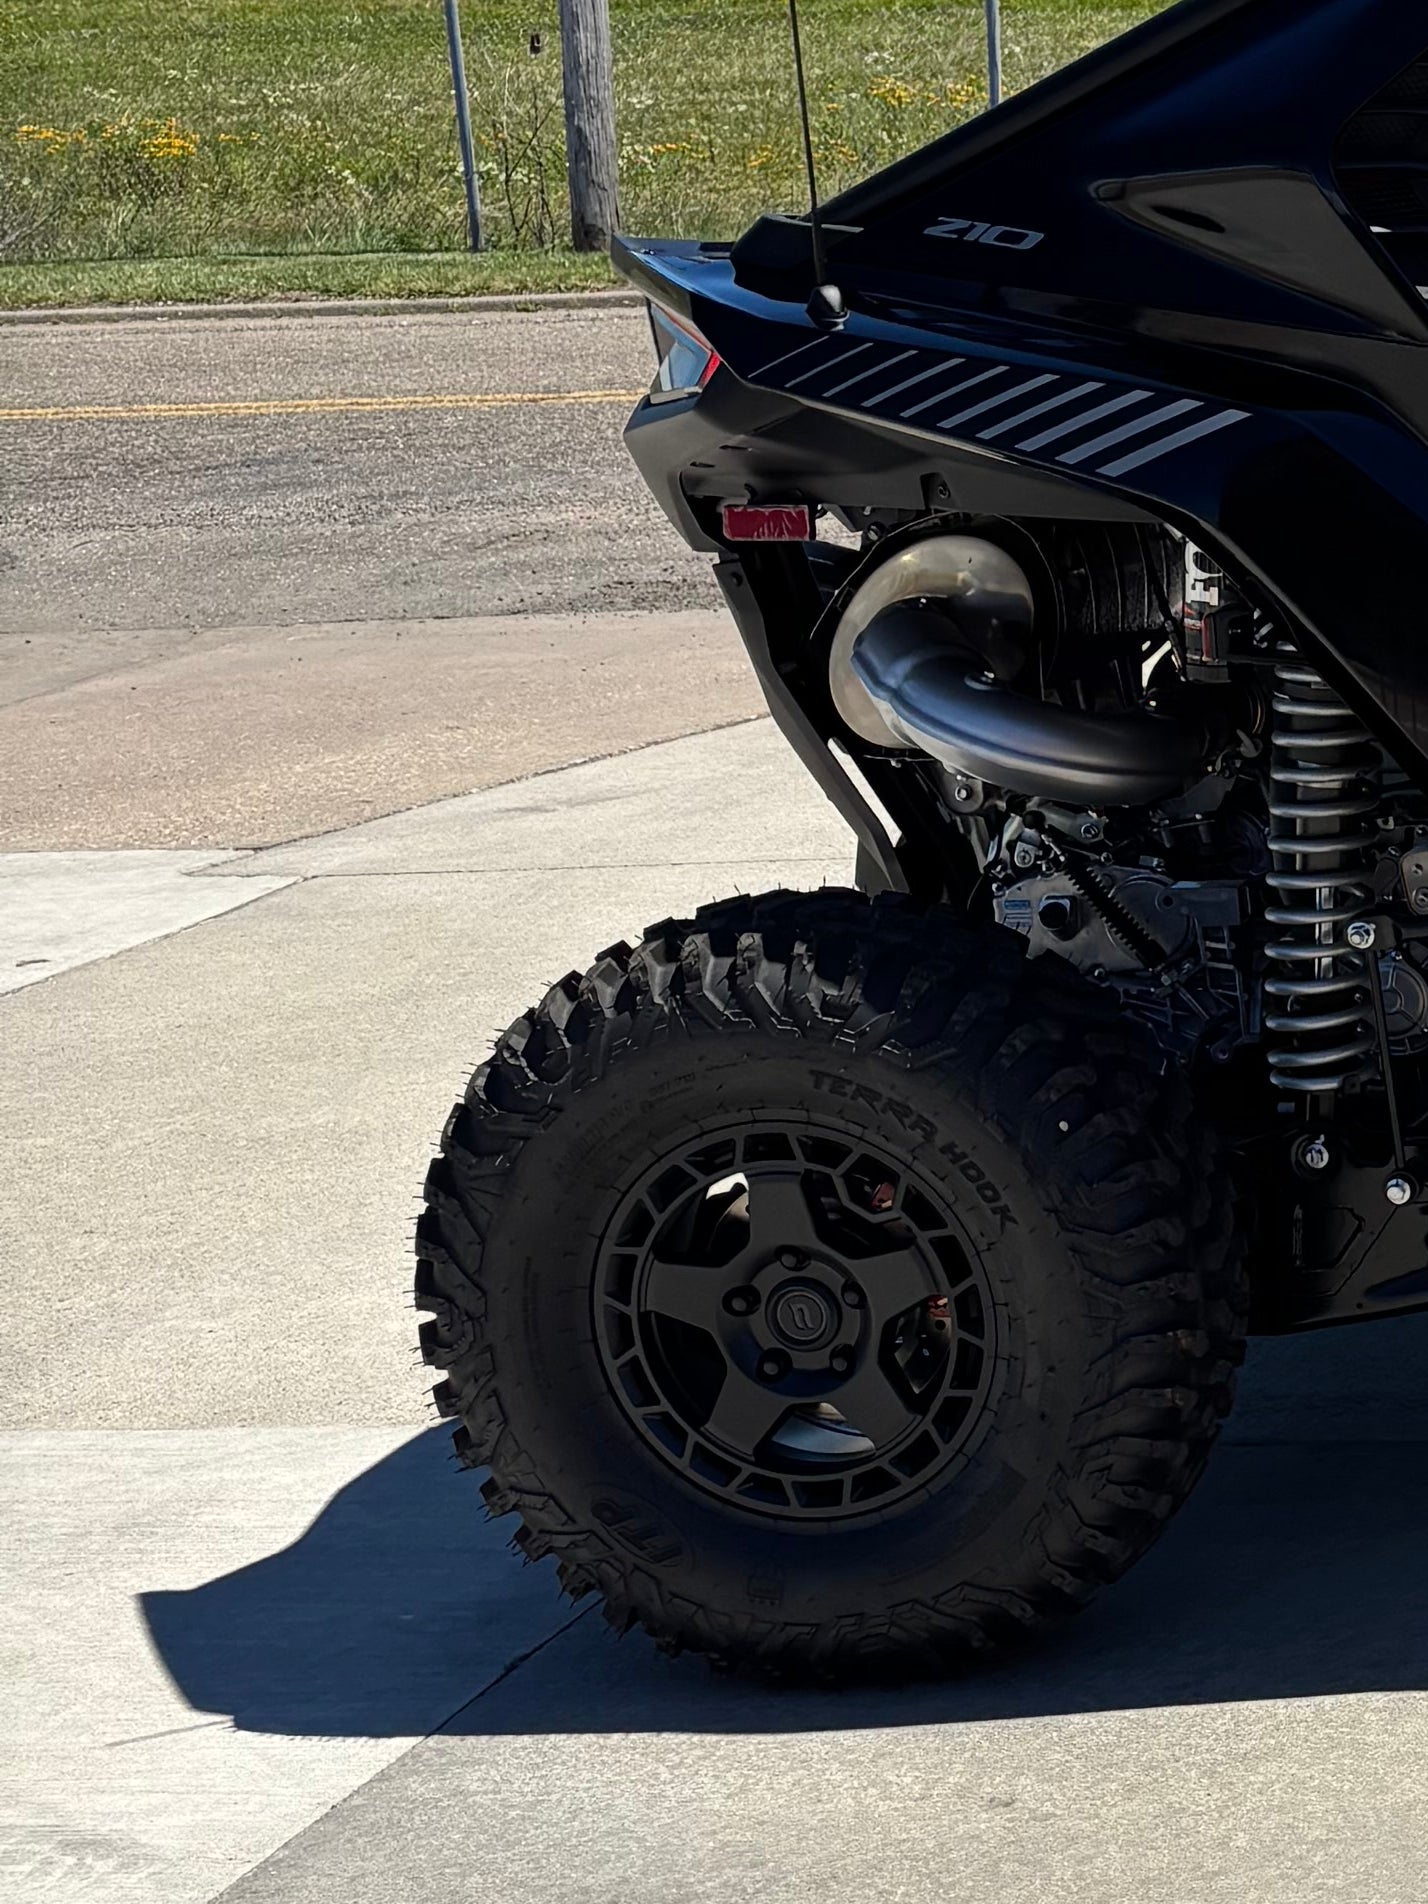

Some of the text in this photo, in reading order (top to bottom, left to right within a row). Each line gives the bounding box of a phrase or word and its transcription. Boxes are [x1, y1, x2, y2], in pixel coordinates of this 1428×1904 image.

[922, 216, 1044, 250] Z10
[1184, 534, 1224, 607] FO
[808, 1069, 1020, 1236] TERRA HOOK
